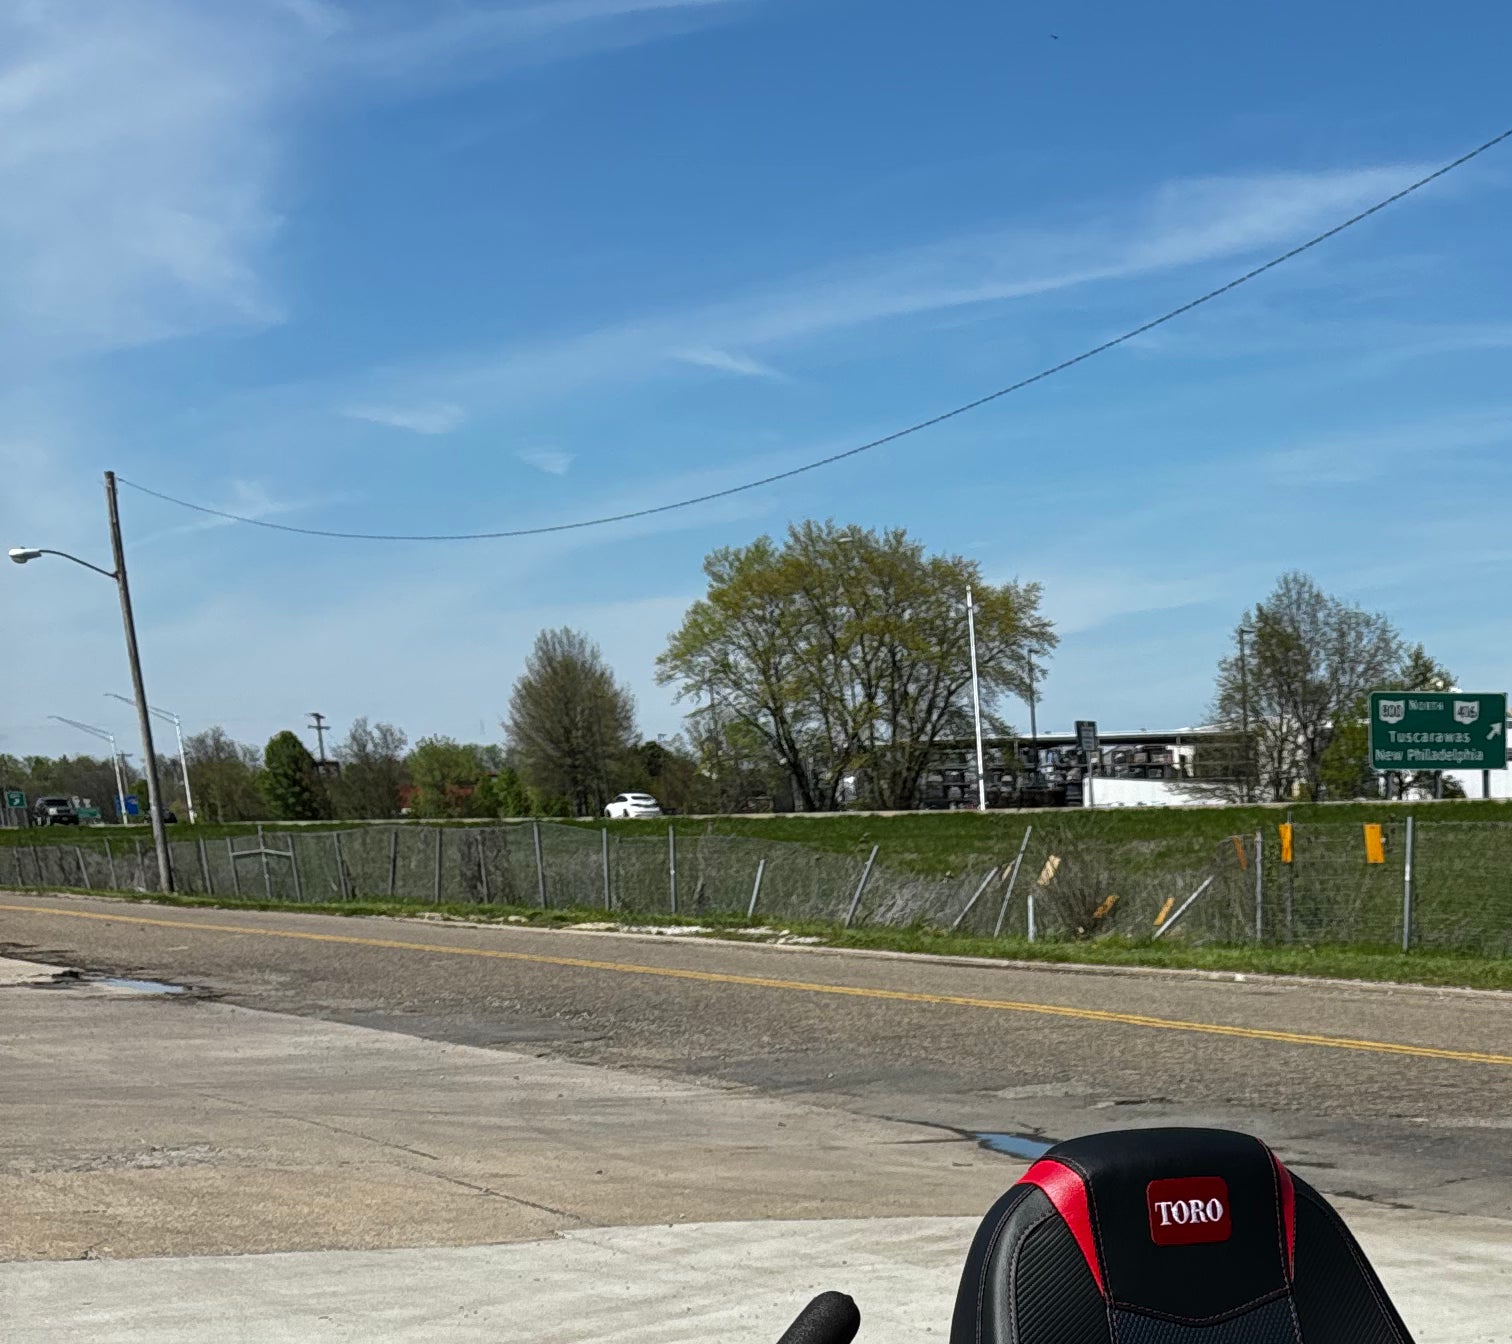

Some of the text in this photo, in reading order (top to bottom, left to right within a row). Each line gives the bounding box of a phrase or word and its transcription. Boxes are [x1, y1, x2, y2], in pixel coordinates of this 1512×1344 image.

[1388, 731, 1472, 743] Tuscarawas
[1375, 748, 1484, 763] New Philadelphia
[1155, 1198, 1223, 1226] TORO
